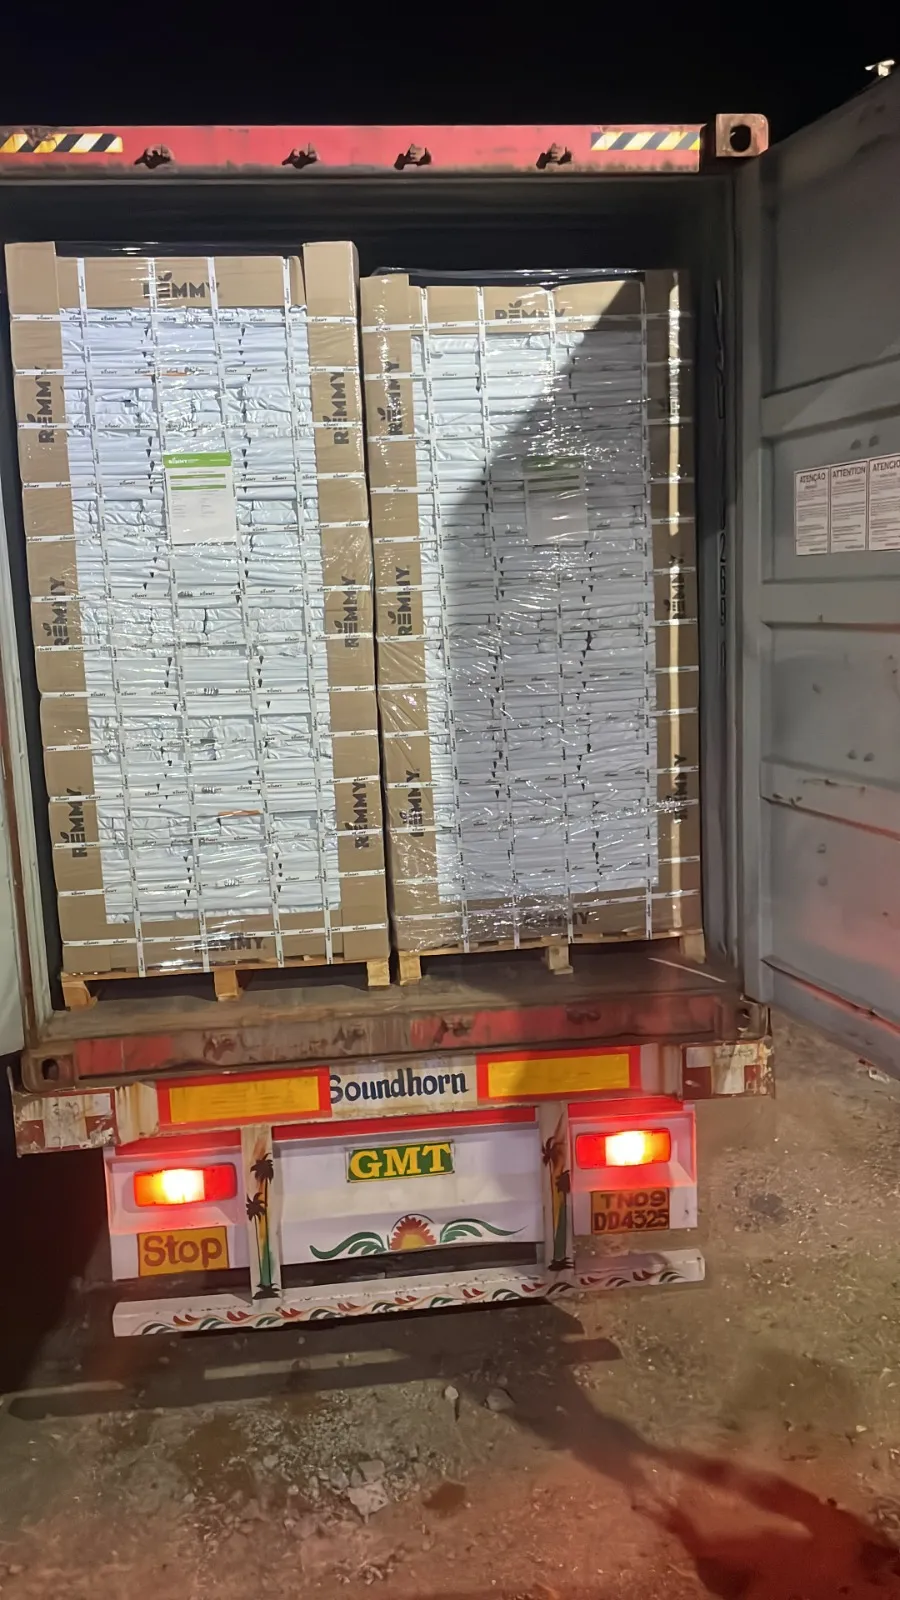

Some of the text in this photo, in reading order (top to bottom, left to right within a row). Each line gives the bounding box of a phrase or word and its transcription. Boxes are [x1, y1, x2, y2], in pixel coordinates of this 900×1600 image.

[832, 466, 866, 479] ATTENTION
[329, 1067, 469, 1104] Soundhorn
[350, 1143, 451, 1179] GMT
[600, 1190, 666, 1209] TN09
[593, 1208, 669, 1231] DD4325
[143, 1235, 223, 1268] Stop
